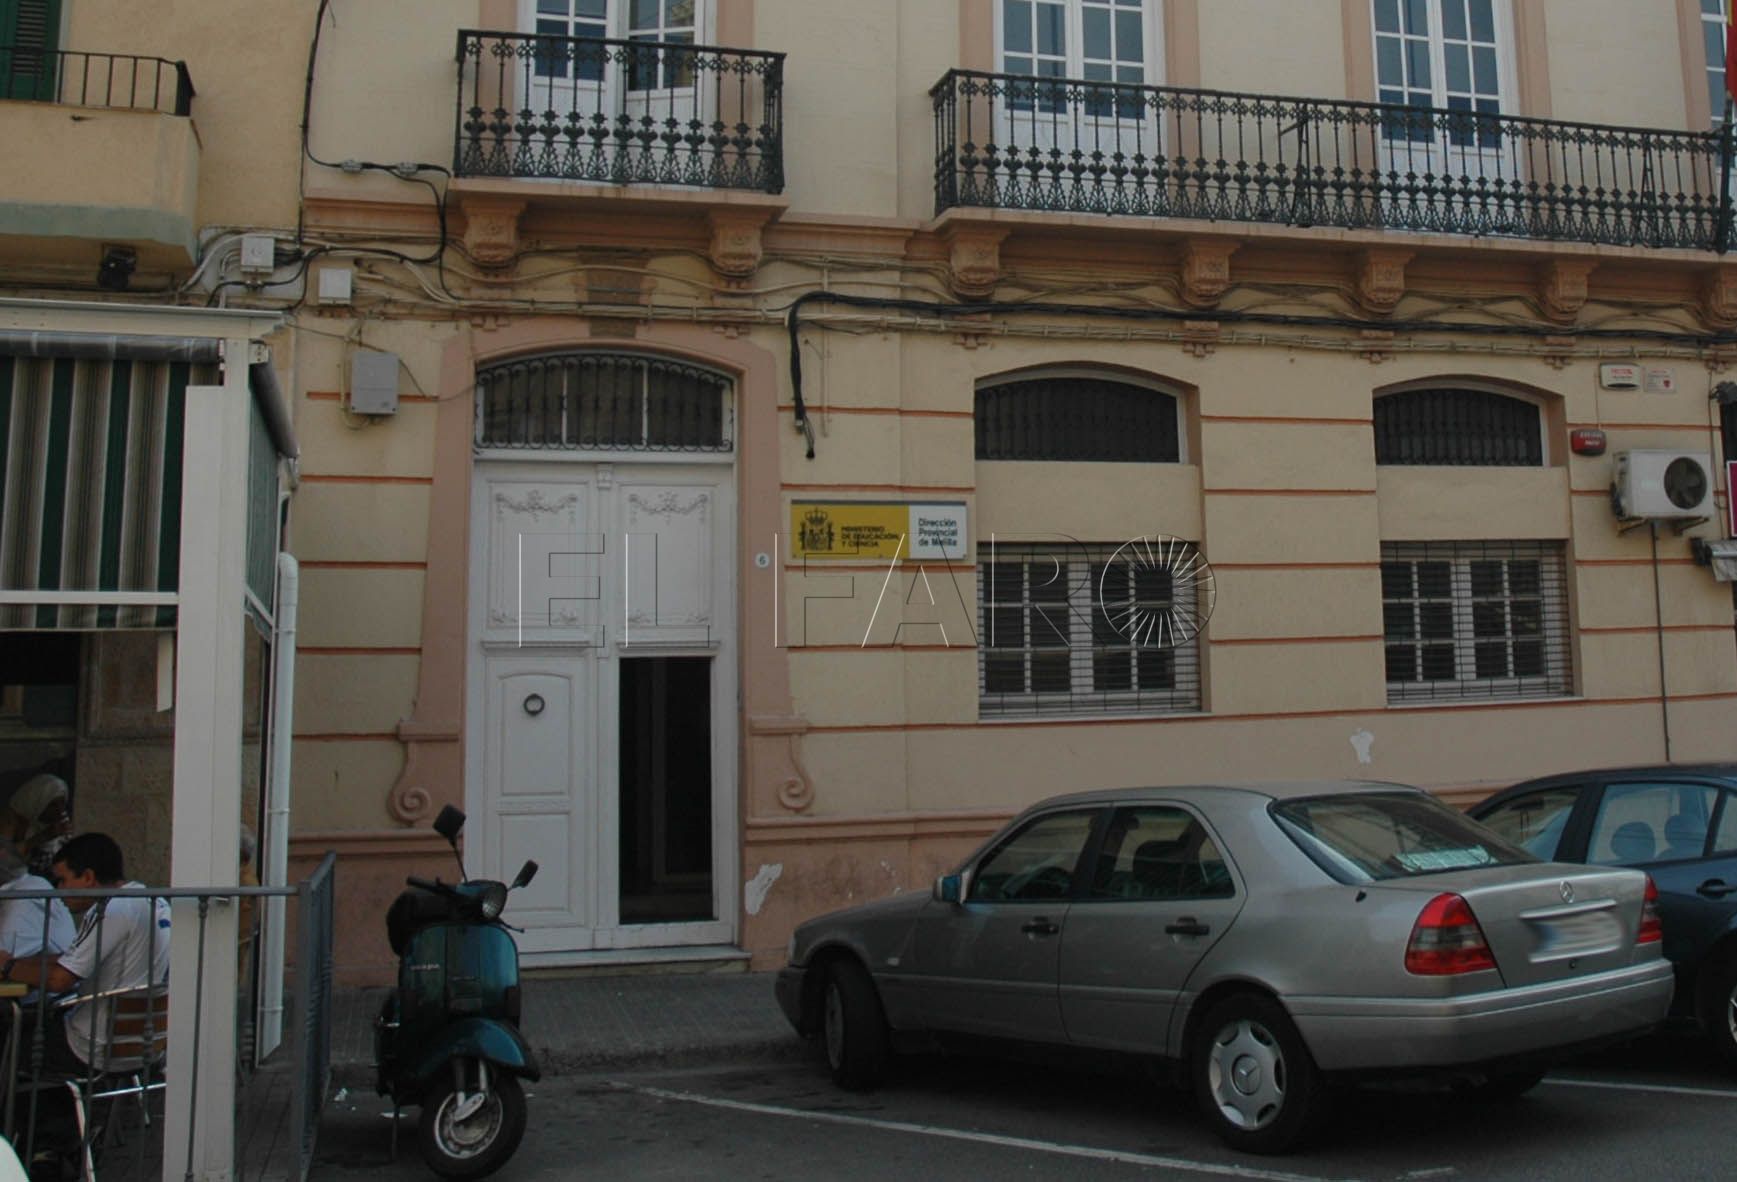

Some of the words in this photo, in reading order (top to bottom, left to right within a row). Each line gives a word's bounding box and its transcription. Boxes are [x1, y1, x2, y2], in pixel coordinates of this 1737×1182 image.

[918, 518, 957, 527] Dirección
[918, 527, 957, 536] Provincial
[918, 538, 928, 546] de
[931, 538, 957, 546] Melilla
